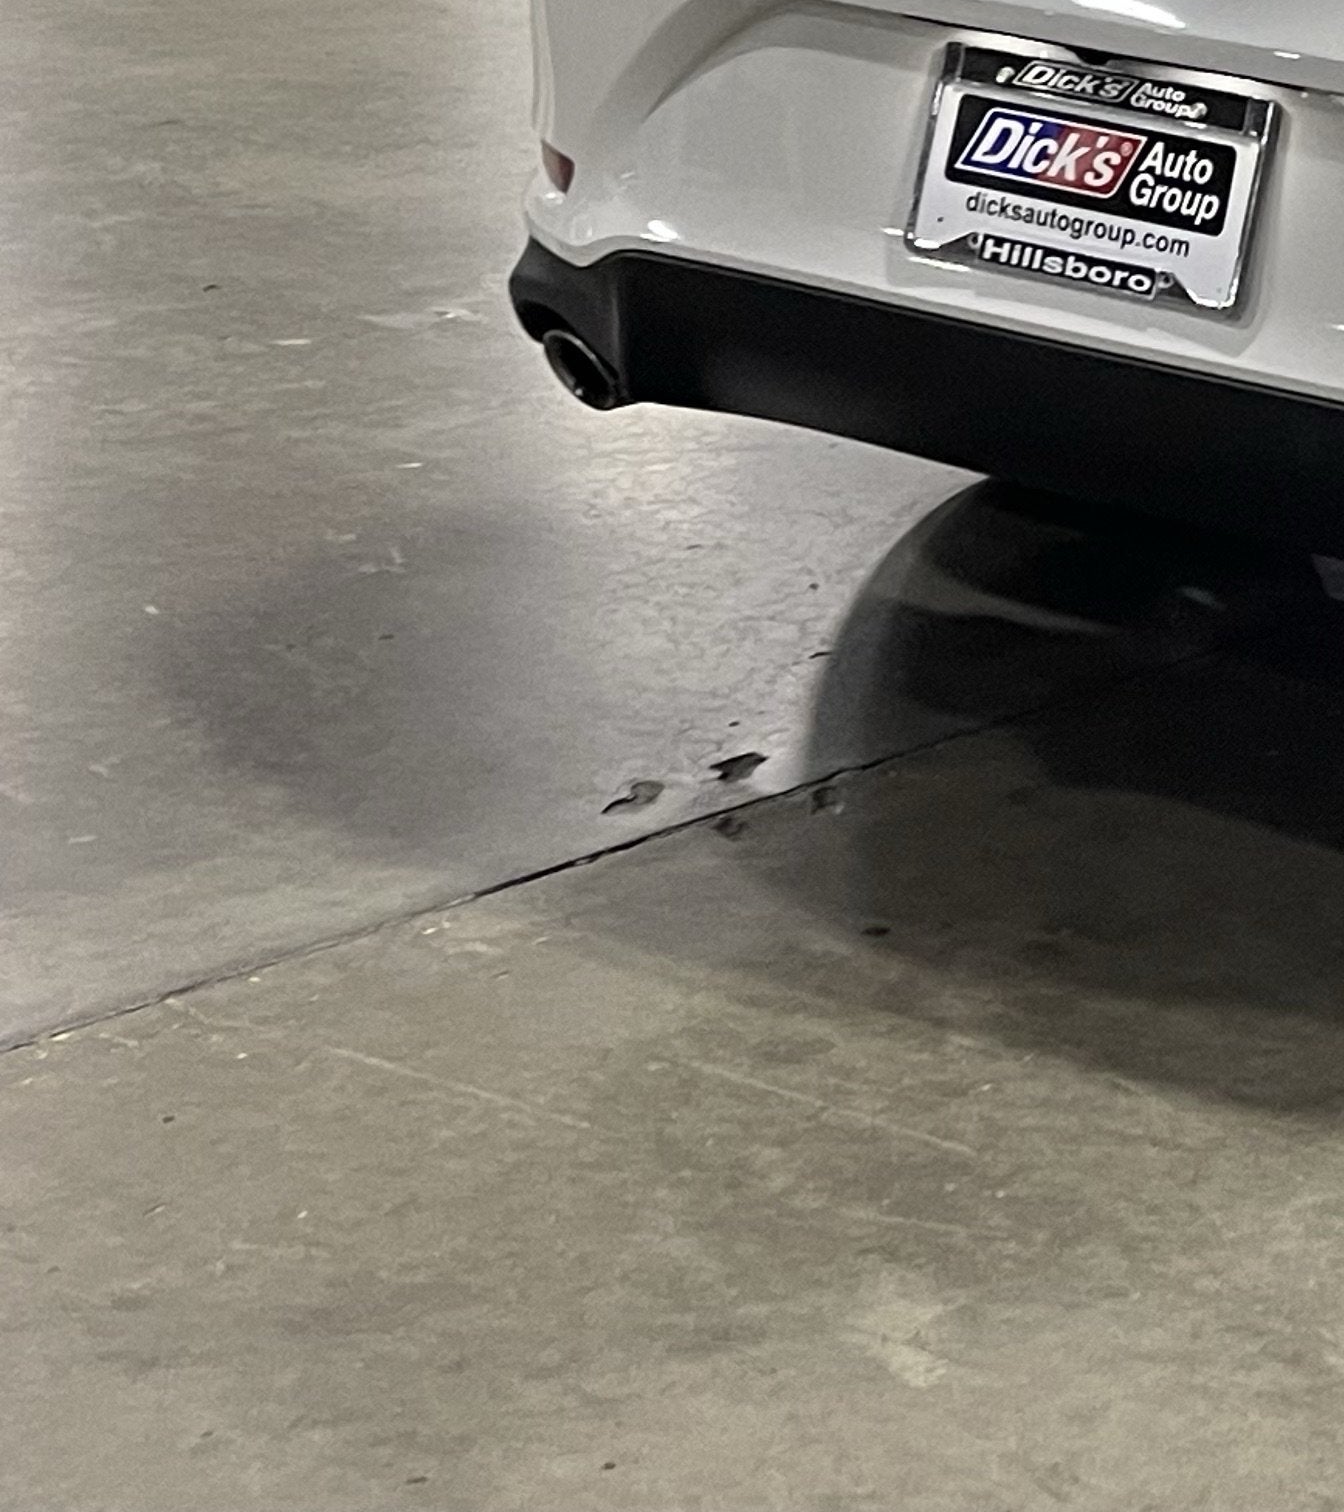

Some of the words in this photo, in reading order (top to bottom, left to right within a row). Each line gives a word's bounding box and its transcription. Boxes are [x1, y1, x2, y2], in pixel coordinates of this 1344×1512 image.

[1022, 65, 1130, 98] Dick's
[1137, 82, 1187, 102] Auto
[1130, 93, 1191, 119] Group
[970, 118, 1122, 187] Dick's
[1138, 141, 1214, 185] Auto
[1129, 173, 1220, 226] Group
[965, 192, 1190, 257] dicksautogroup.com
[981, 238, 1152, 293] Hillsboro
